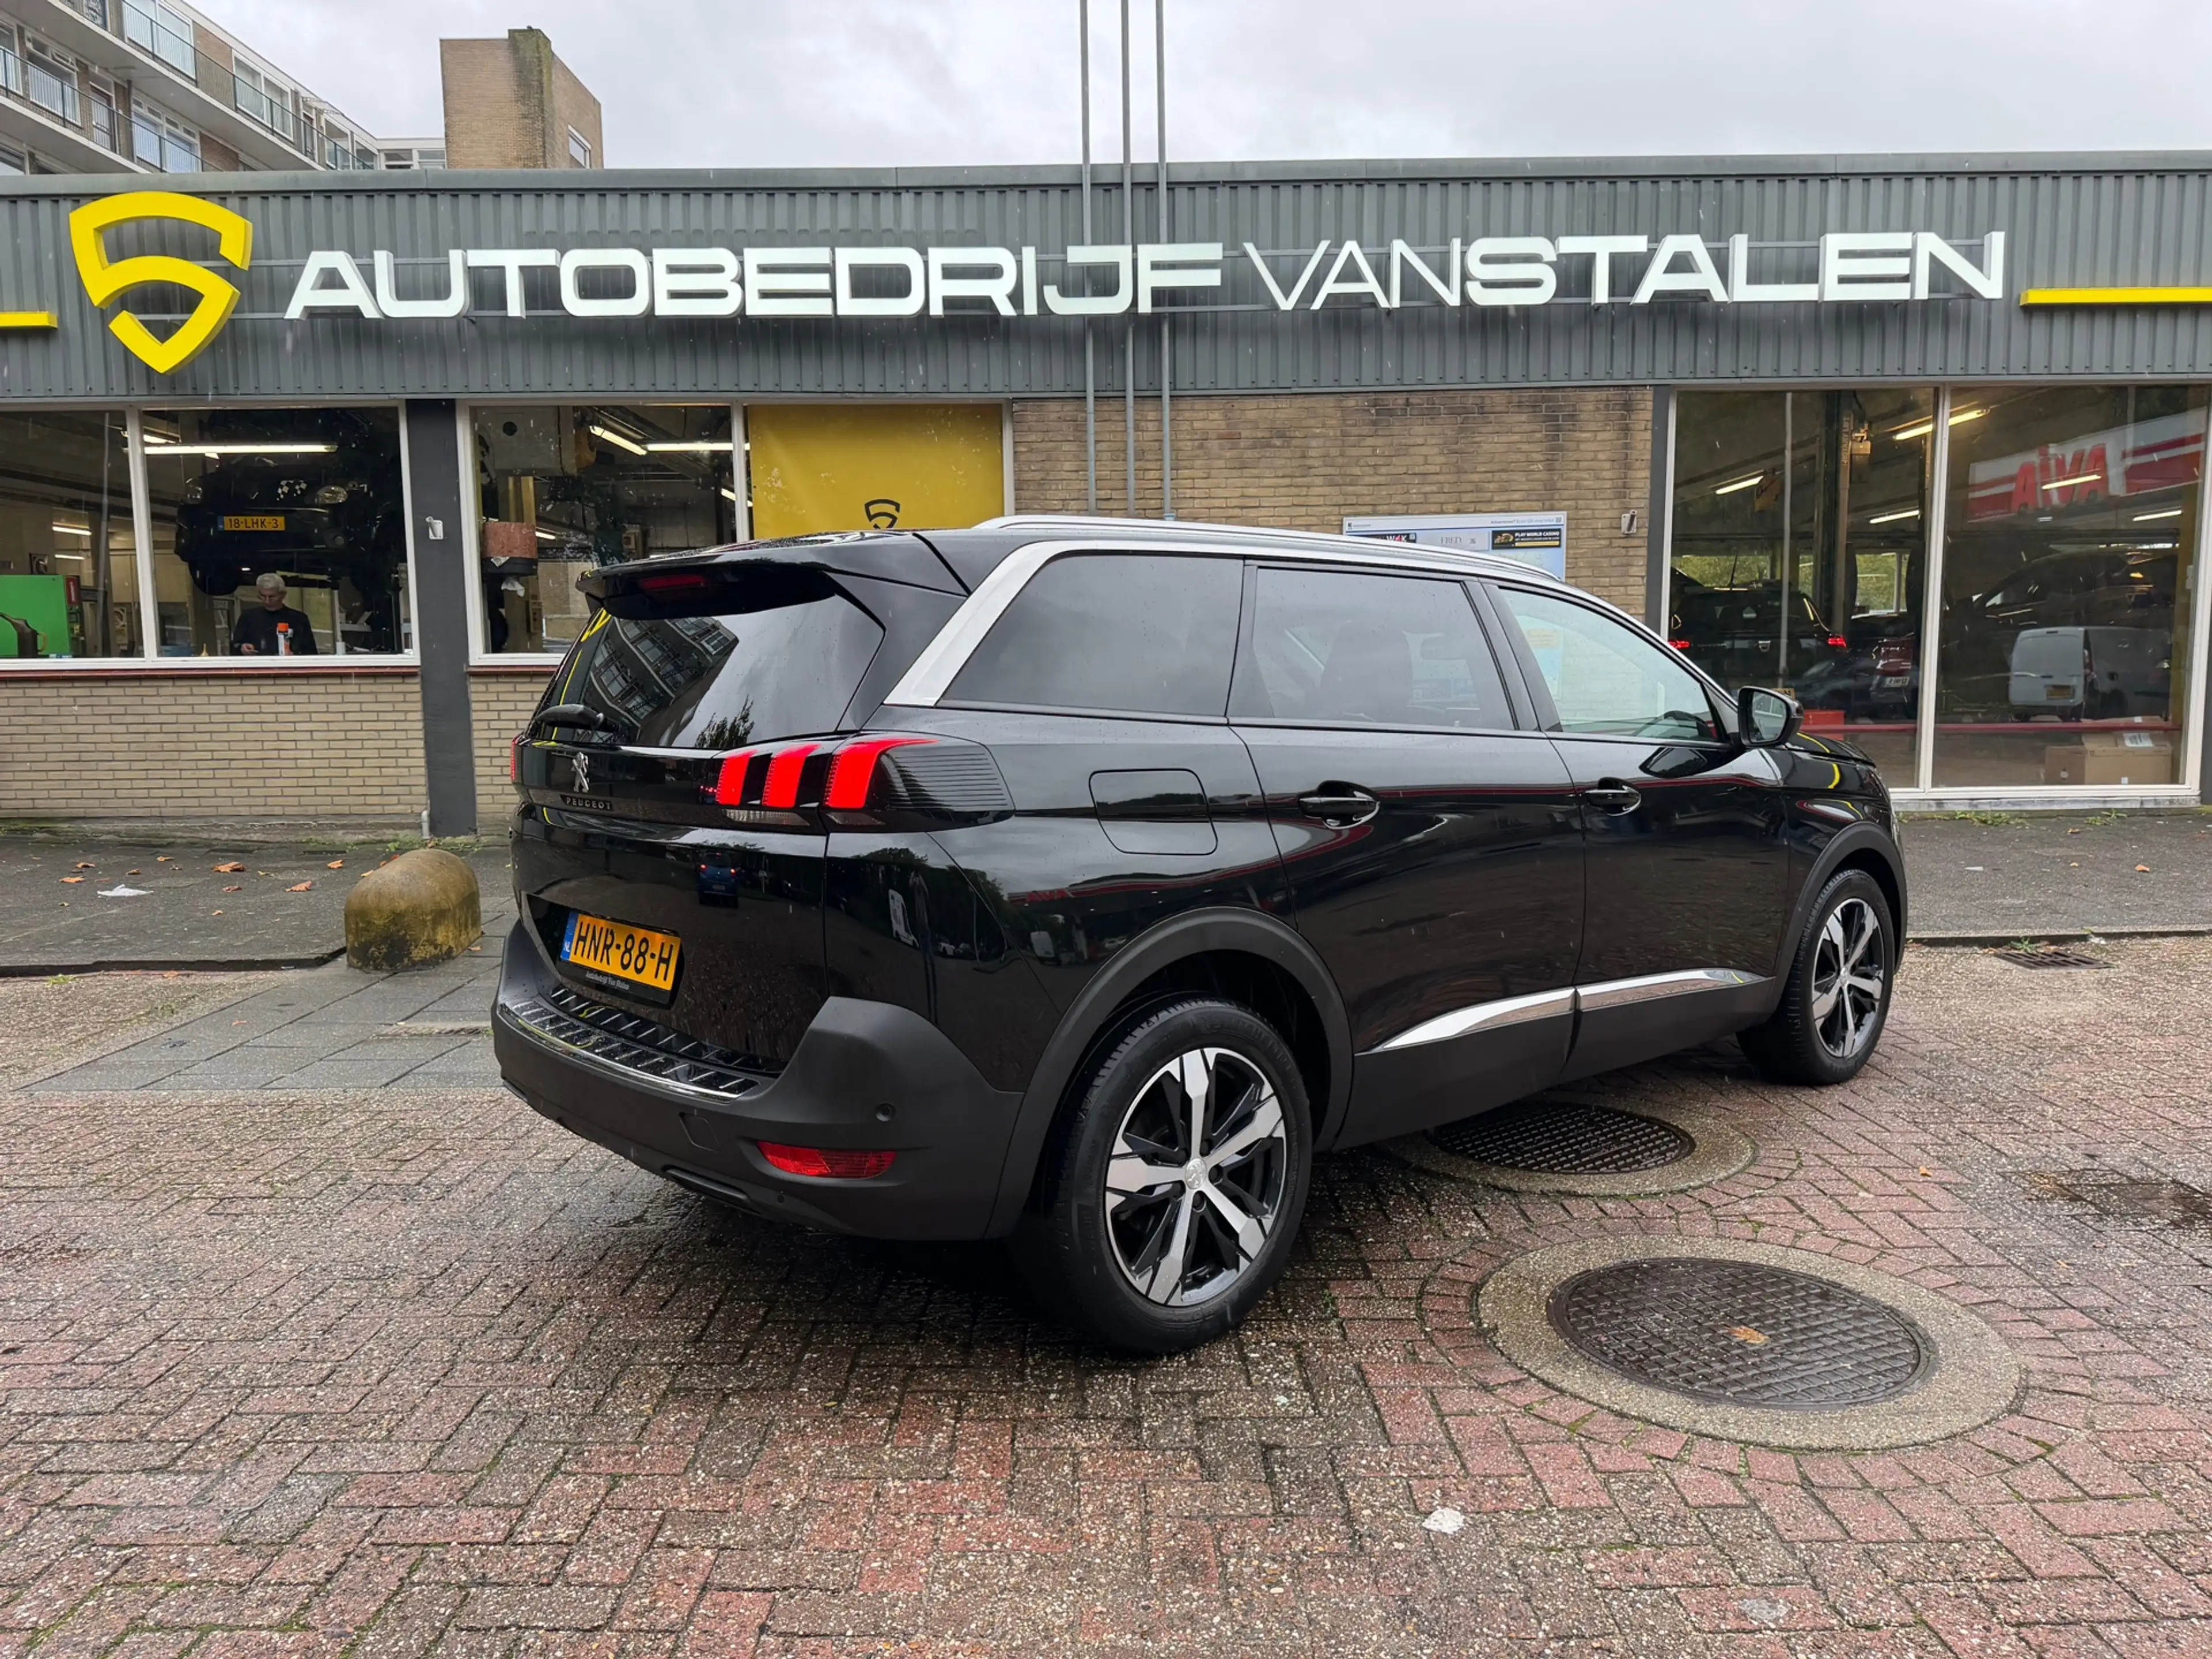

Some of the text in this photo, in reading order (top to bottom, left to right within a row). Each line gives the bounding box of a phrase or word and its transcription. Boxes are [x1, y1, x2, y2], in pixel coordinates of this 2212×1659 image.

[283, 241, 1224, 320] AUTOBEDRIJF
[228, 518, 279, 529] 18-LHK-3
[566, 797, 611, 810] PEUGEOT
[574, 921, 674, 982] HNR-88-H
